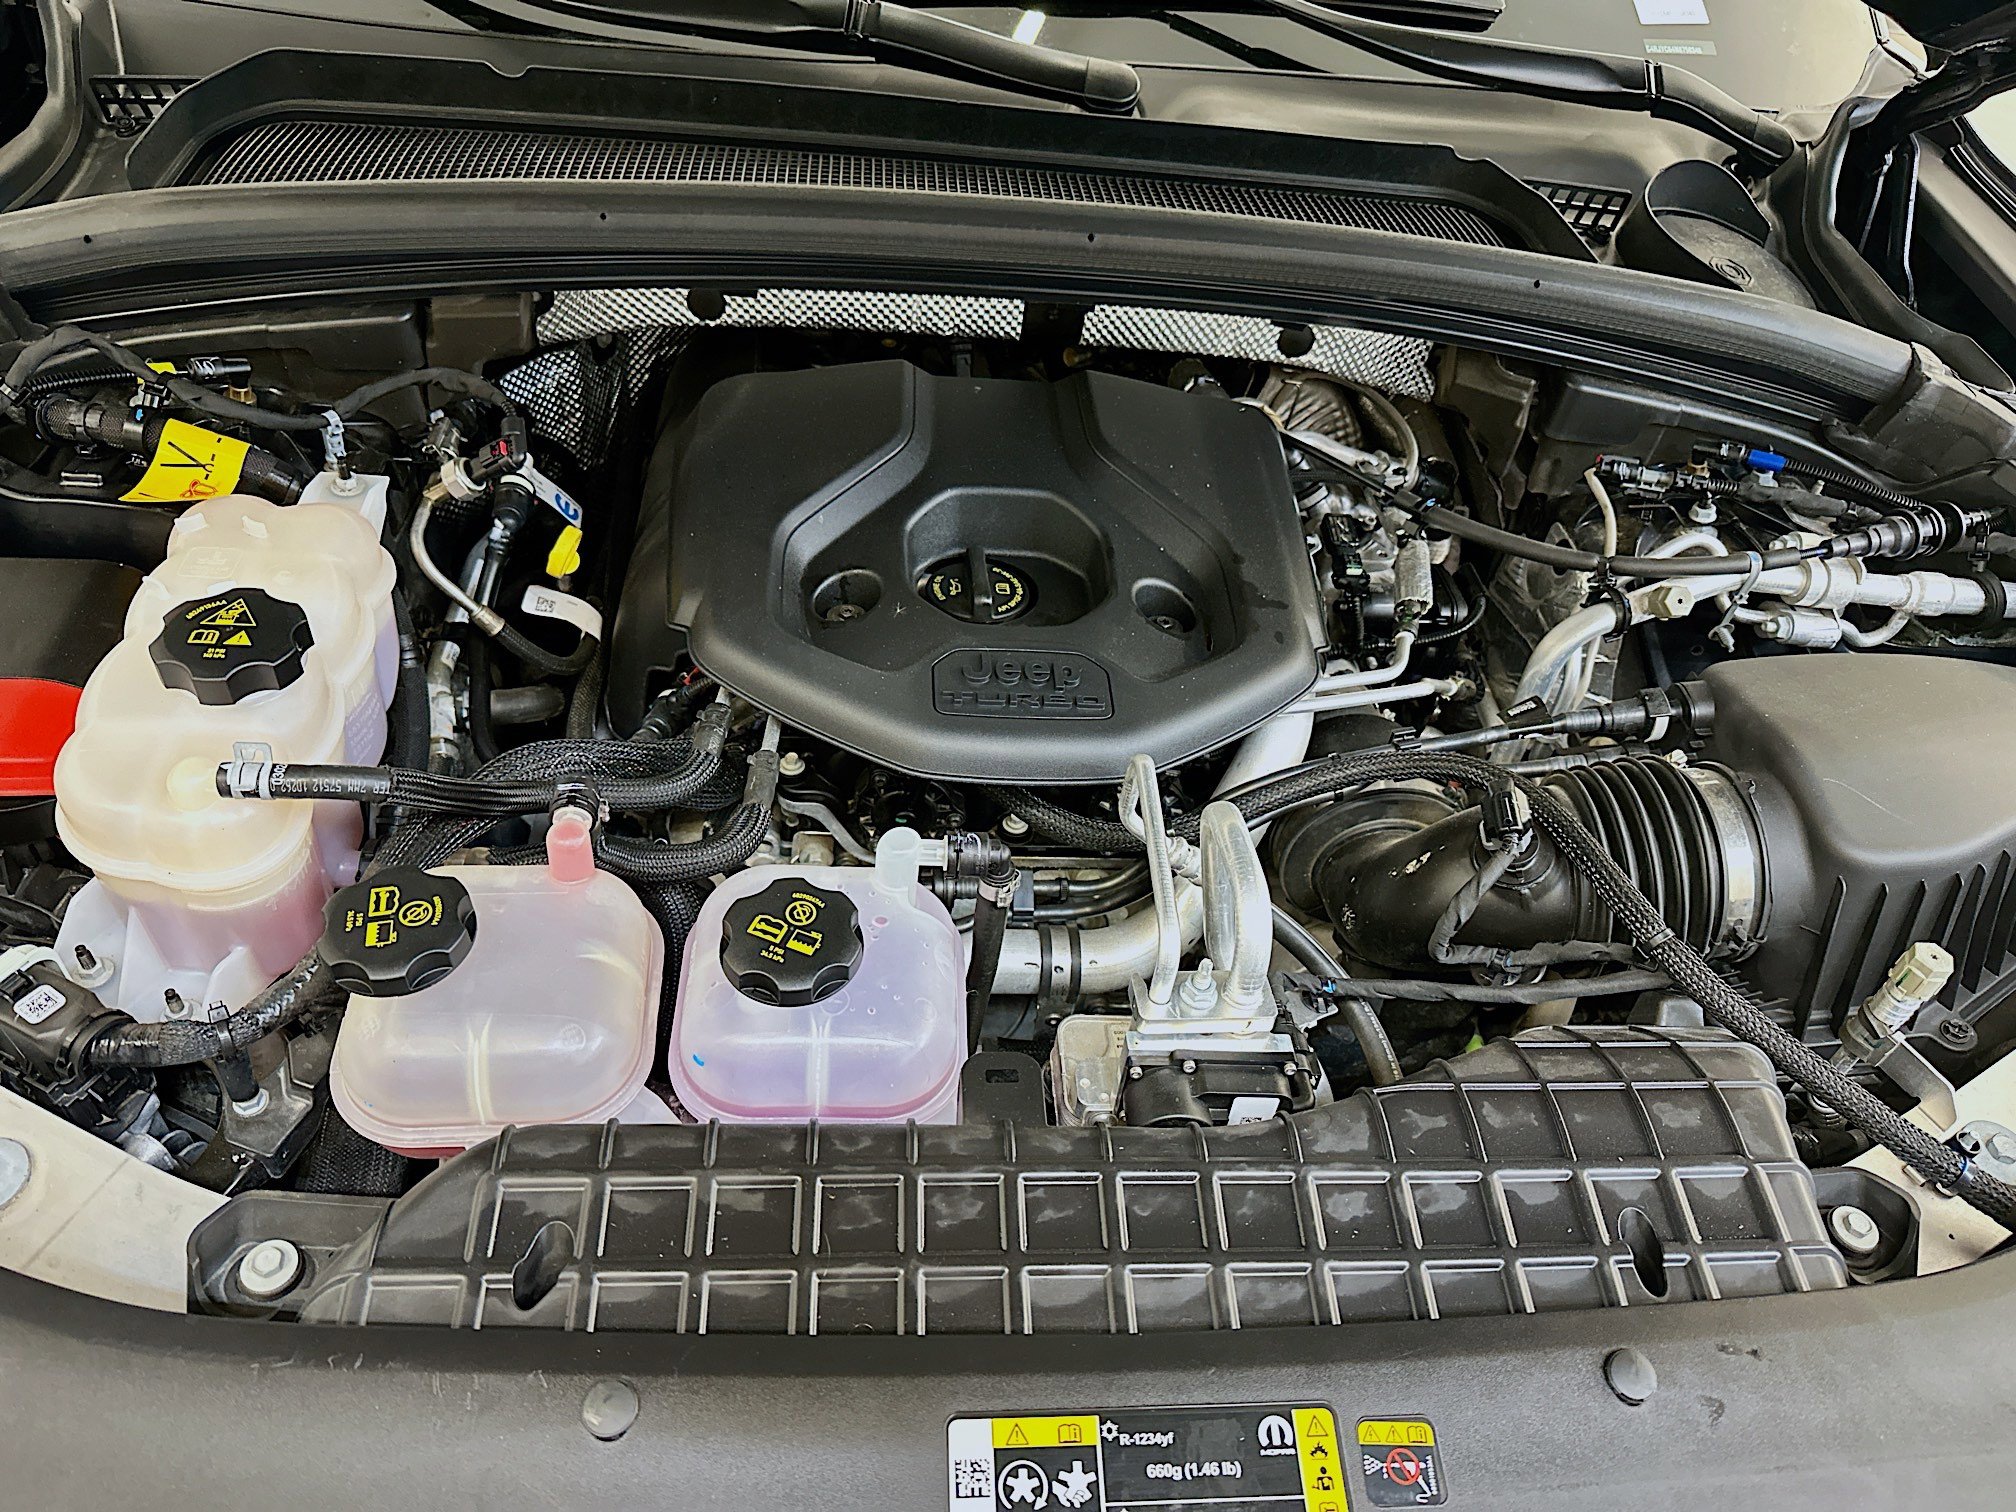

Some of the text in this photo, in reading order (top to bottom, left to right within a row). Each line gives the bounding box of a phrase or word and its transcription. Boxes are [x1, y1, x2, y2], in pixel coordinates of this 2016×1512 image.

[961, 654, 1081, 693] Jeep
[942, 690, 1106, 711] TURBO
[1119, 1431, 1175, 1447] R-1234yf
[1146, 1461, 1243, 1481] 660g (1.46 lb)
